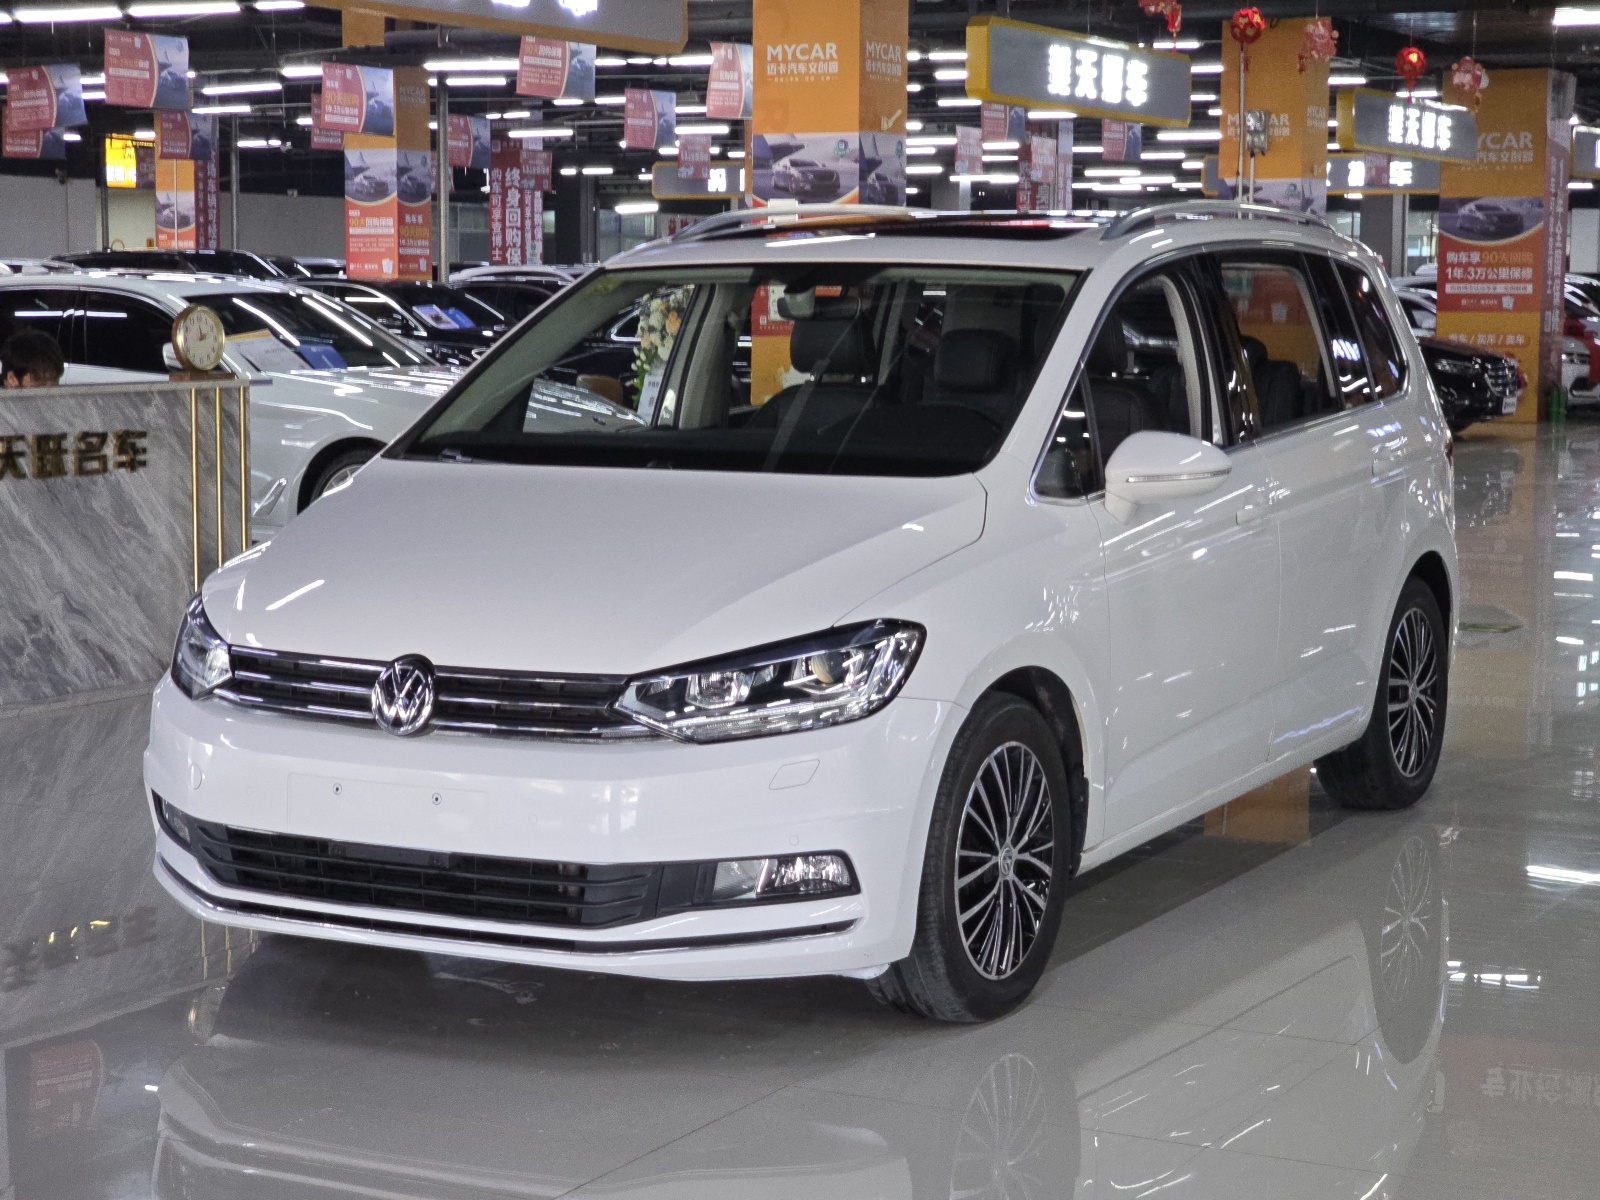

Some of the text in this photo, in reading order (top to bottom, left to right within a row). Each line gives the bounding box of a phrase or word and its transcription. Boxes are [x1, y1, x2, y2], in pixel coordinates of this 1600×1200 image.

[767, 42, 838, 61] MYCAR
[866, 41, 902, 62] MYCAR
[1227, 113, 1290, 125] MAR
[1477, 132, 1533, 149] YCAR
